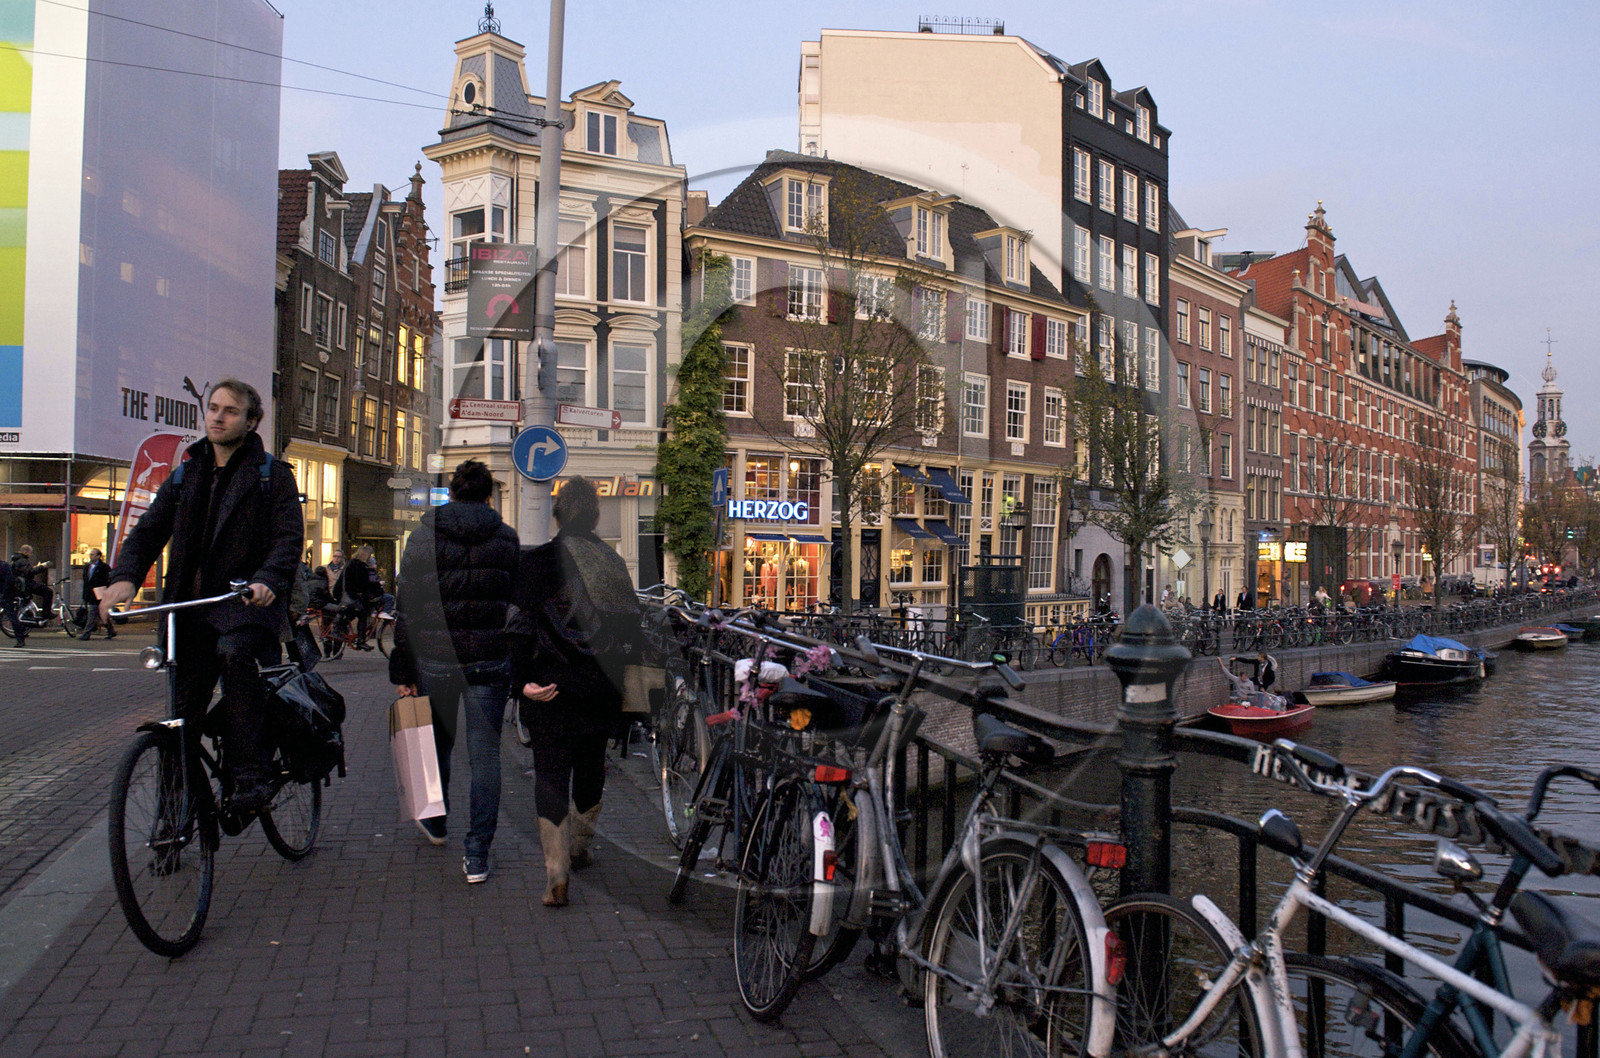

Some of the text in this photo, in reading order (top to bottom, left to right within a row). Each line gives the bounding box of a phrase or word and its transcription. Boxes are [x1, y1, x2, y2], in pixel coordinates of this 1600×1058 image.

[472, 248, 528, 262] IBIZA
[121, 387, 198, 431] THE PUMA
[569, 408, 604, 416] Kalvertoren
[727, 499, 809, 520] HERZOG
